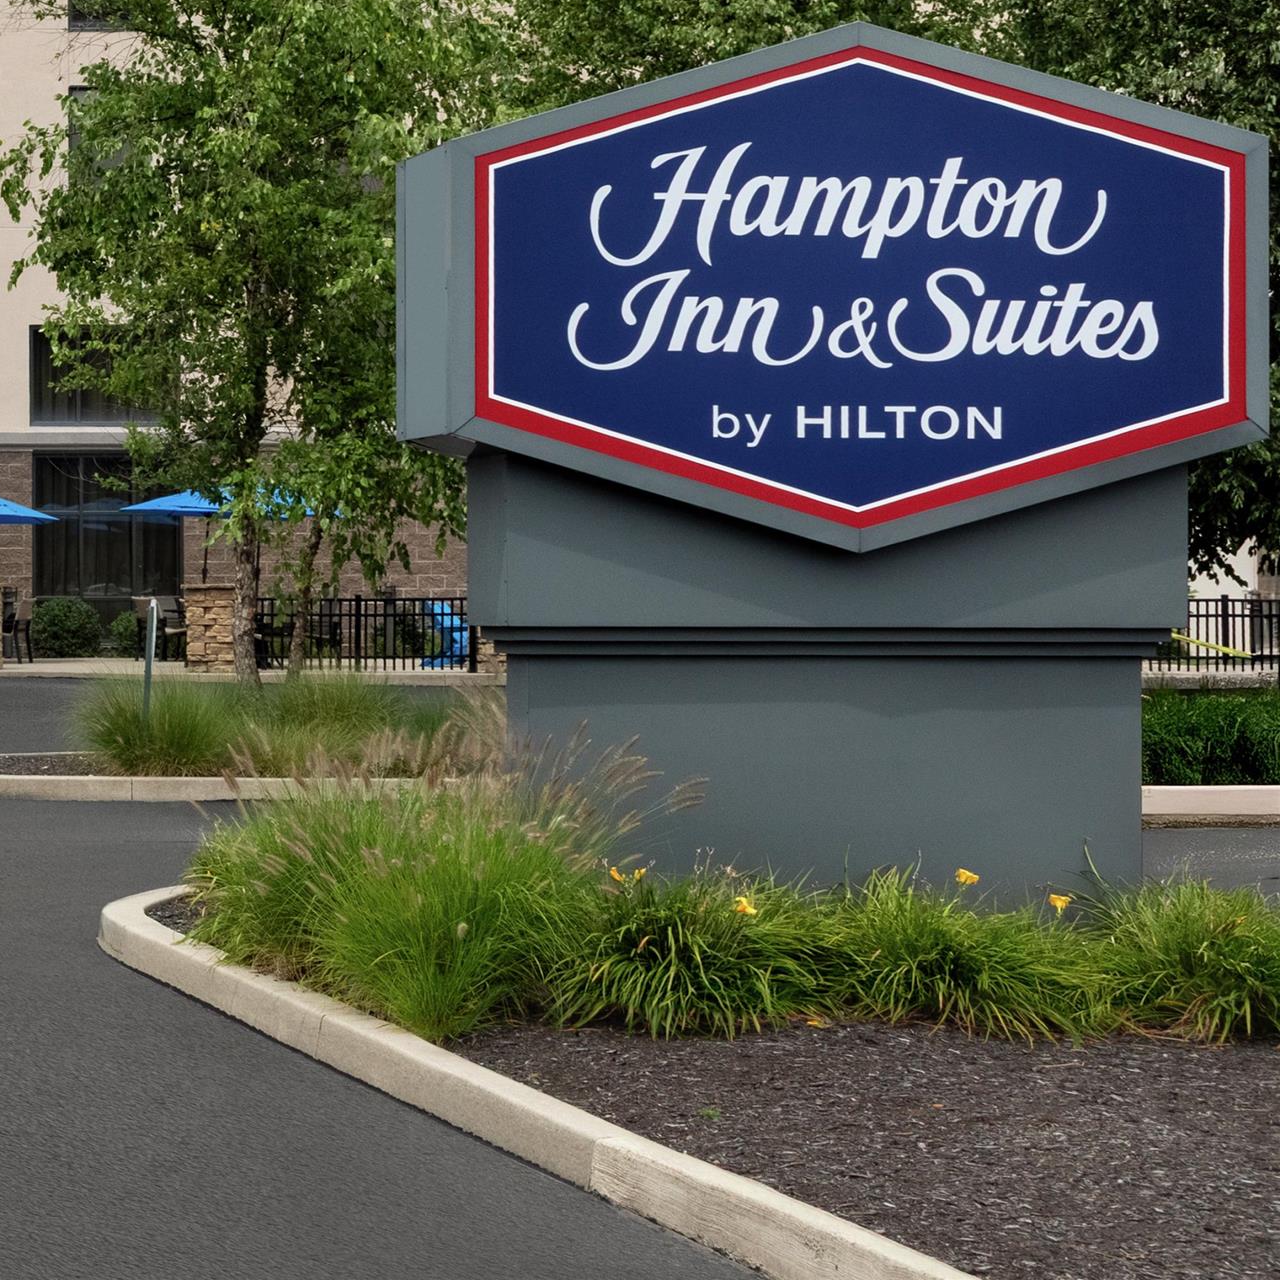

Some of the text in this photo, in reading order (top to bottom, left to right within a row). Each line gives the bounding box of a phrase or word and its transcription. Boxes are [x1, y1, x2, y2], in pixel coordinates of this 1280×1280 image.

[589, 141, 1107, 267] Hampton
[567, 267, 1160, 371] Inn & Suites
[711, 404, 1003, 448] by HILTON
